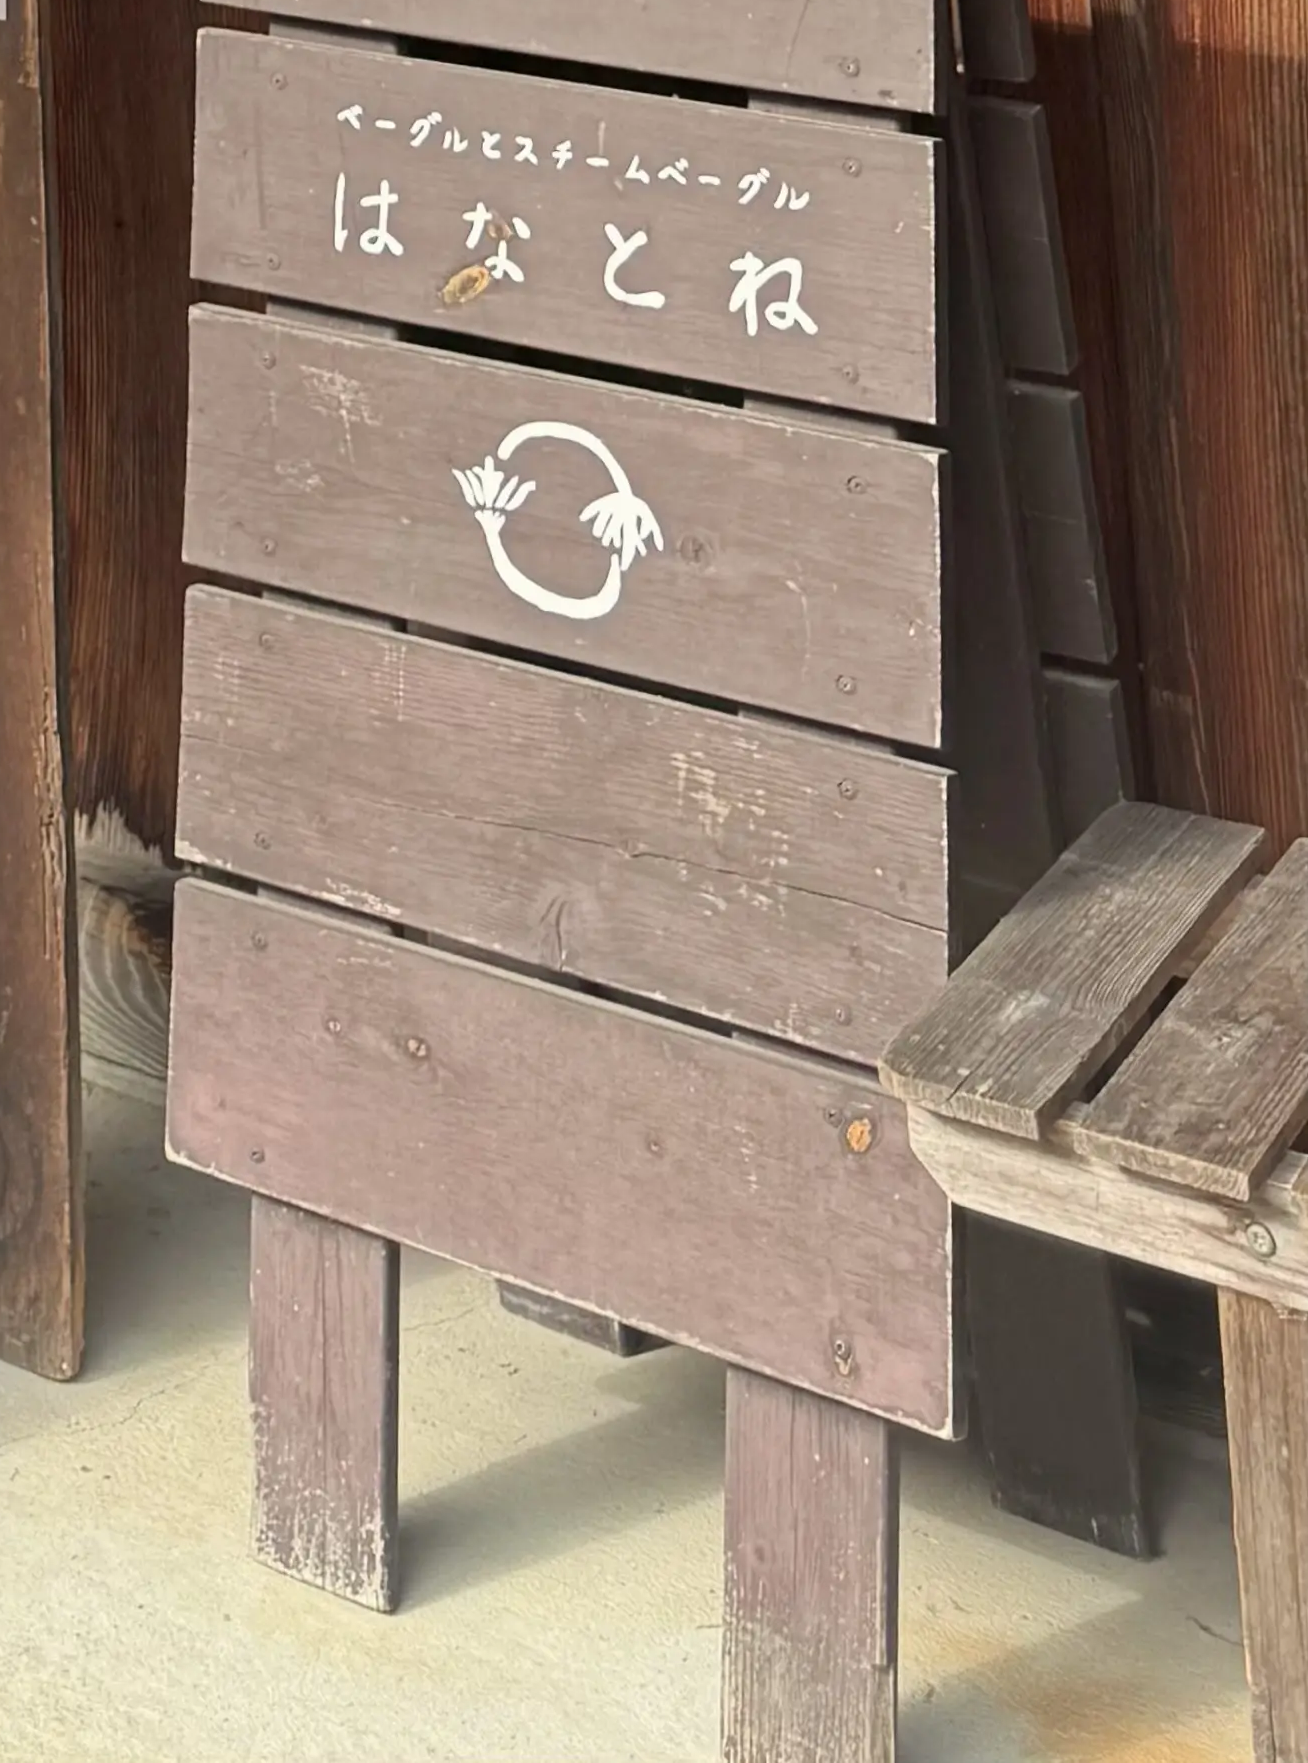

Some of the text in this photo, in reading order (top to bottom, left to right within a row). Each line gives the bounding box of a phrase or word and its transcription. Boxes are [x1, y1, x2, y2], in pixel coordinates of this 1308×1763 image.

[337, 103, 811, 211] ベーグルとスチームベーグル
[333, 172, 819, 337] はなとね
